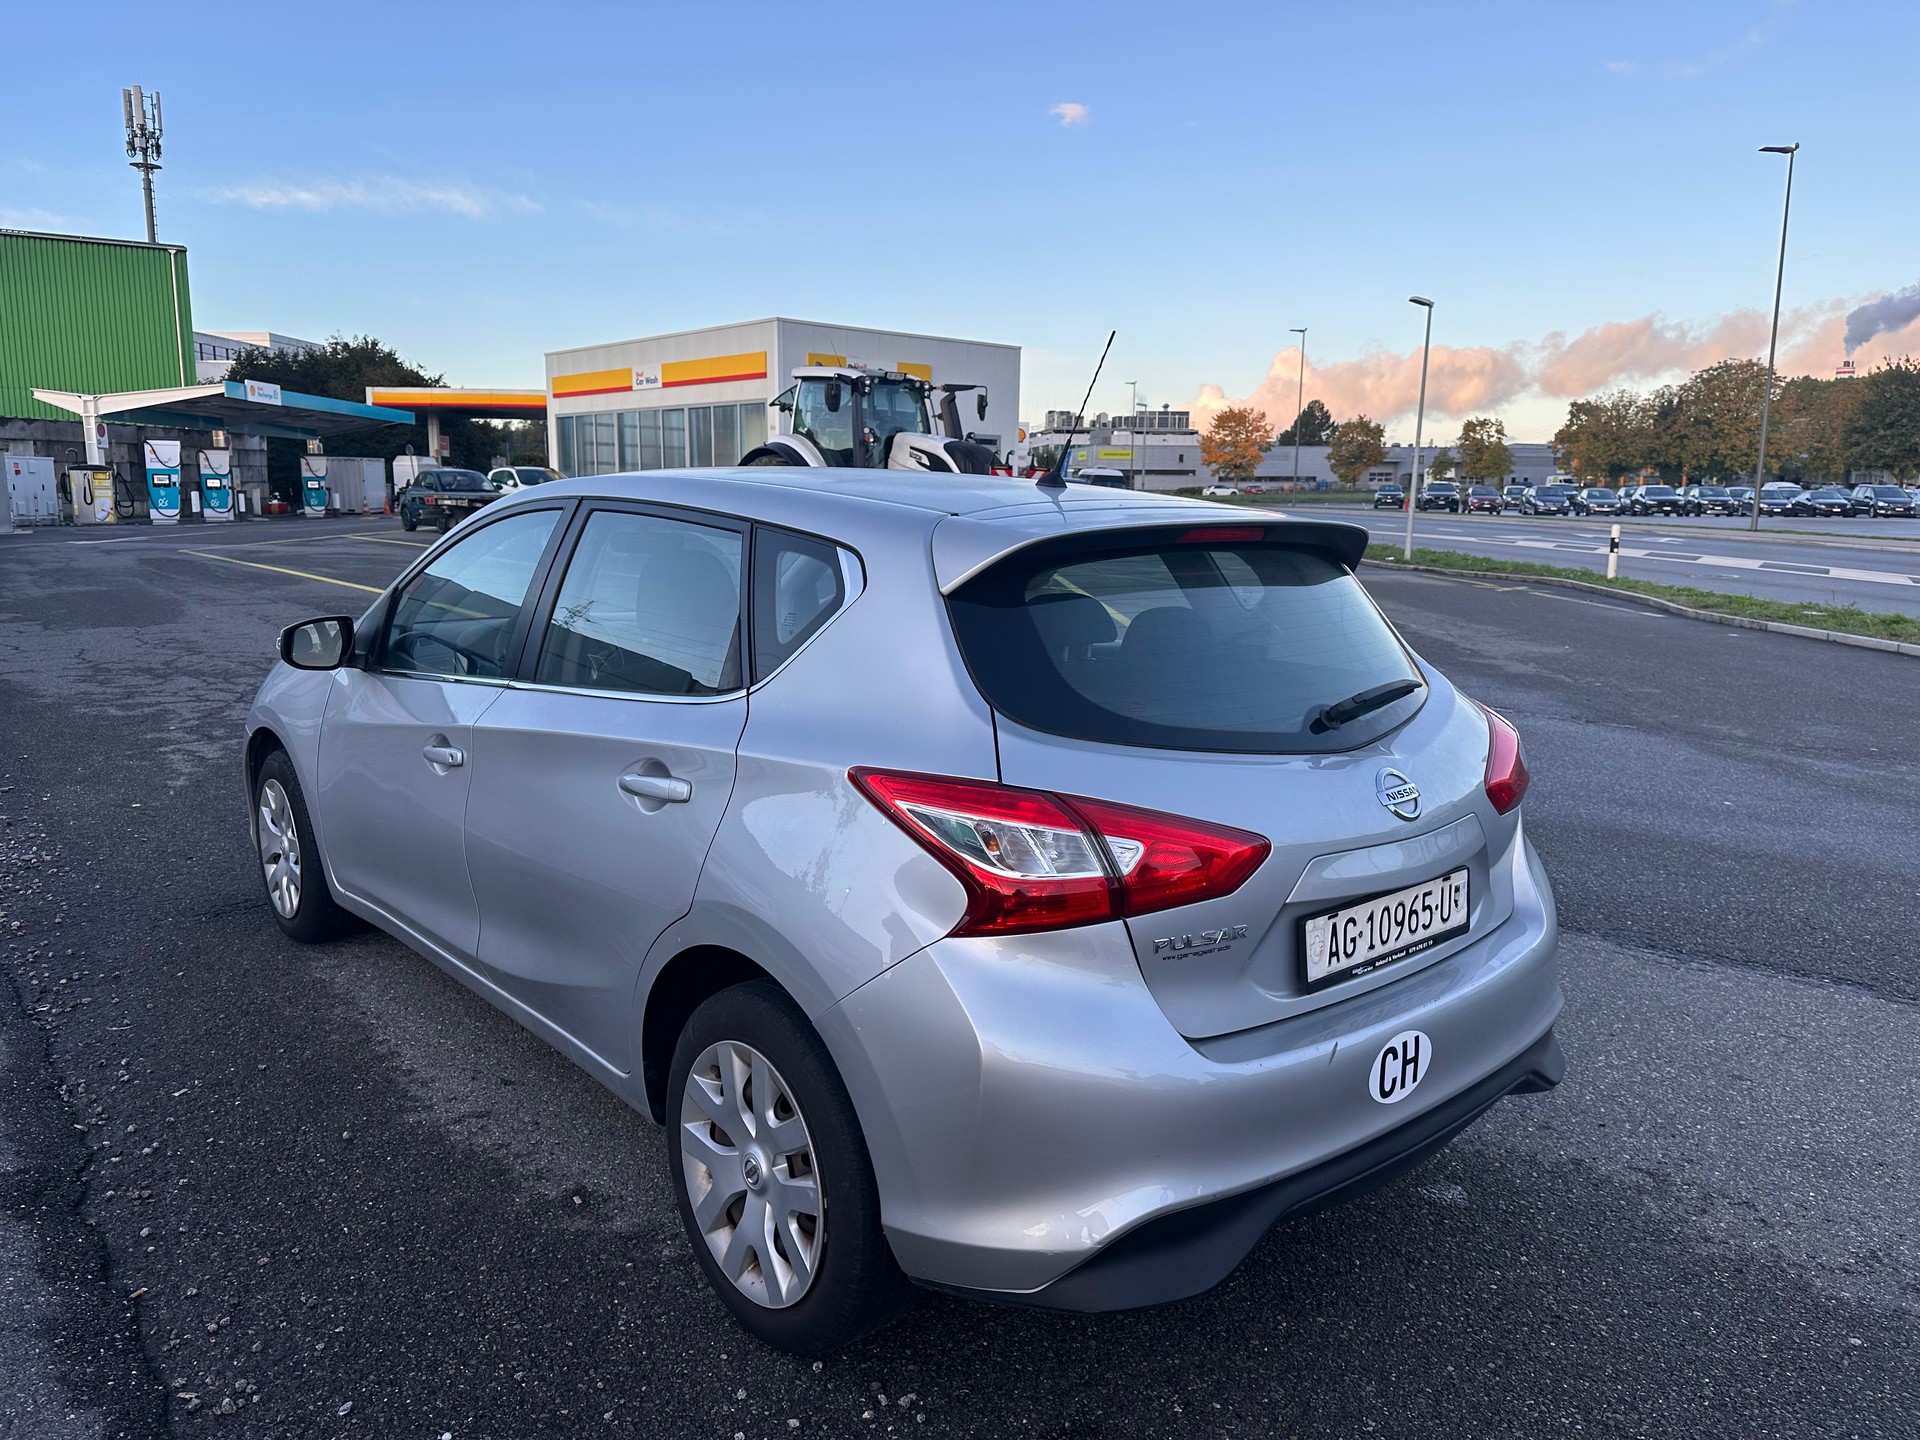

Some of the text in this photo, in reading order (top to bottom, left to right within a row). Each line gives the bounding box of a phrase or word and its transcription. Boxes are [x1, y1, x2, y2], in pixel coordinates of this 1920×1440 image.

[636, 375, 658, 386] Car Wash
[1153, 924, 1248, 954] PULSAR
[1379, 1034, 1420, 1099] CH
